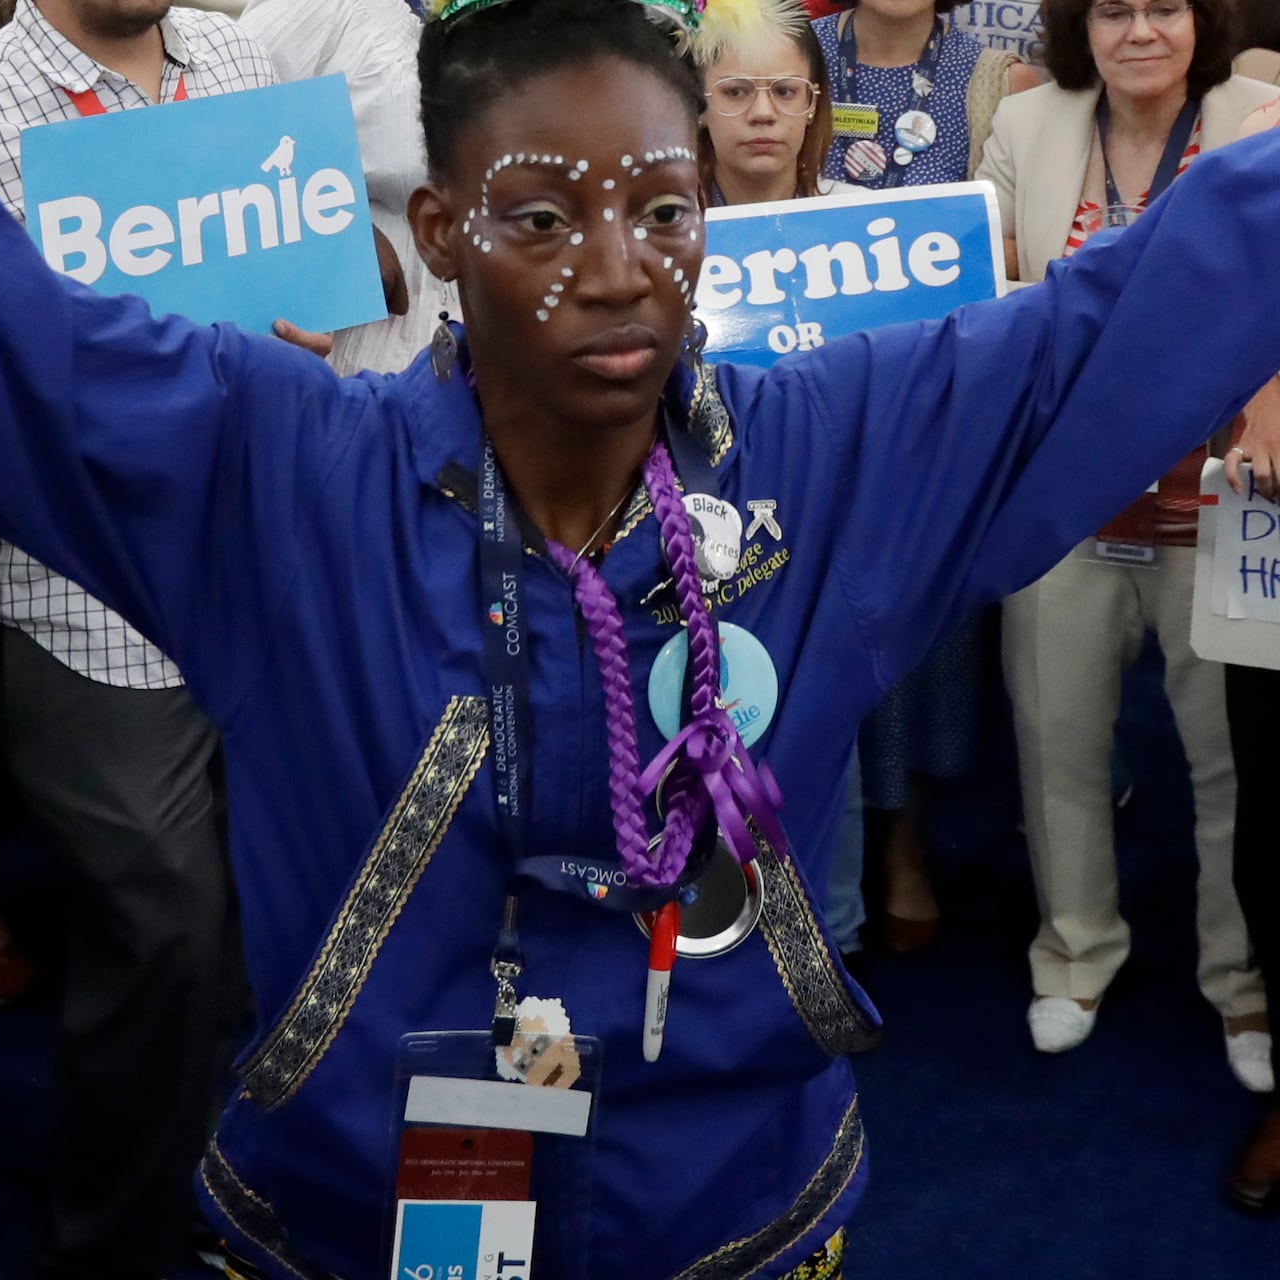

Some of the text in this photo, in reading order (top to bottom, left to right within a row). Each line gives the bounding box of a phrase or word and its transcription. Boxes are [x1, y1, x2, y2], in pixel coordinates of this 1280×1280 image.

[832, 116, 876, 125] ALESTINIAN
[38, 165, 356, 286] Bernie
[693, 217, 961, 311] ernie
[767, 321, 825, 354] OR
[693, 498, 727, 521] Black
[505, 571, 521, 656] COMCAST
[736, 547, 791, 598] Delegate
[492, 684, 507, 772] DEMOCRATIC
[504, 684, 520, 817] NATIONAL CONVENTION
